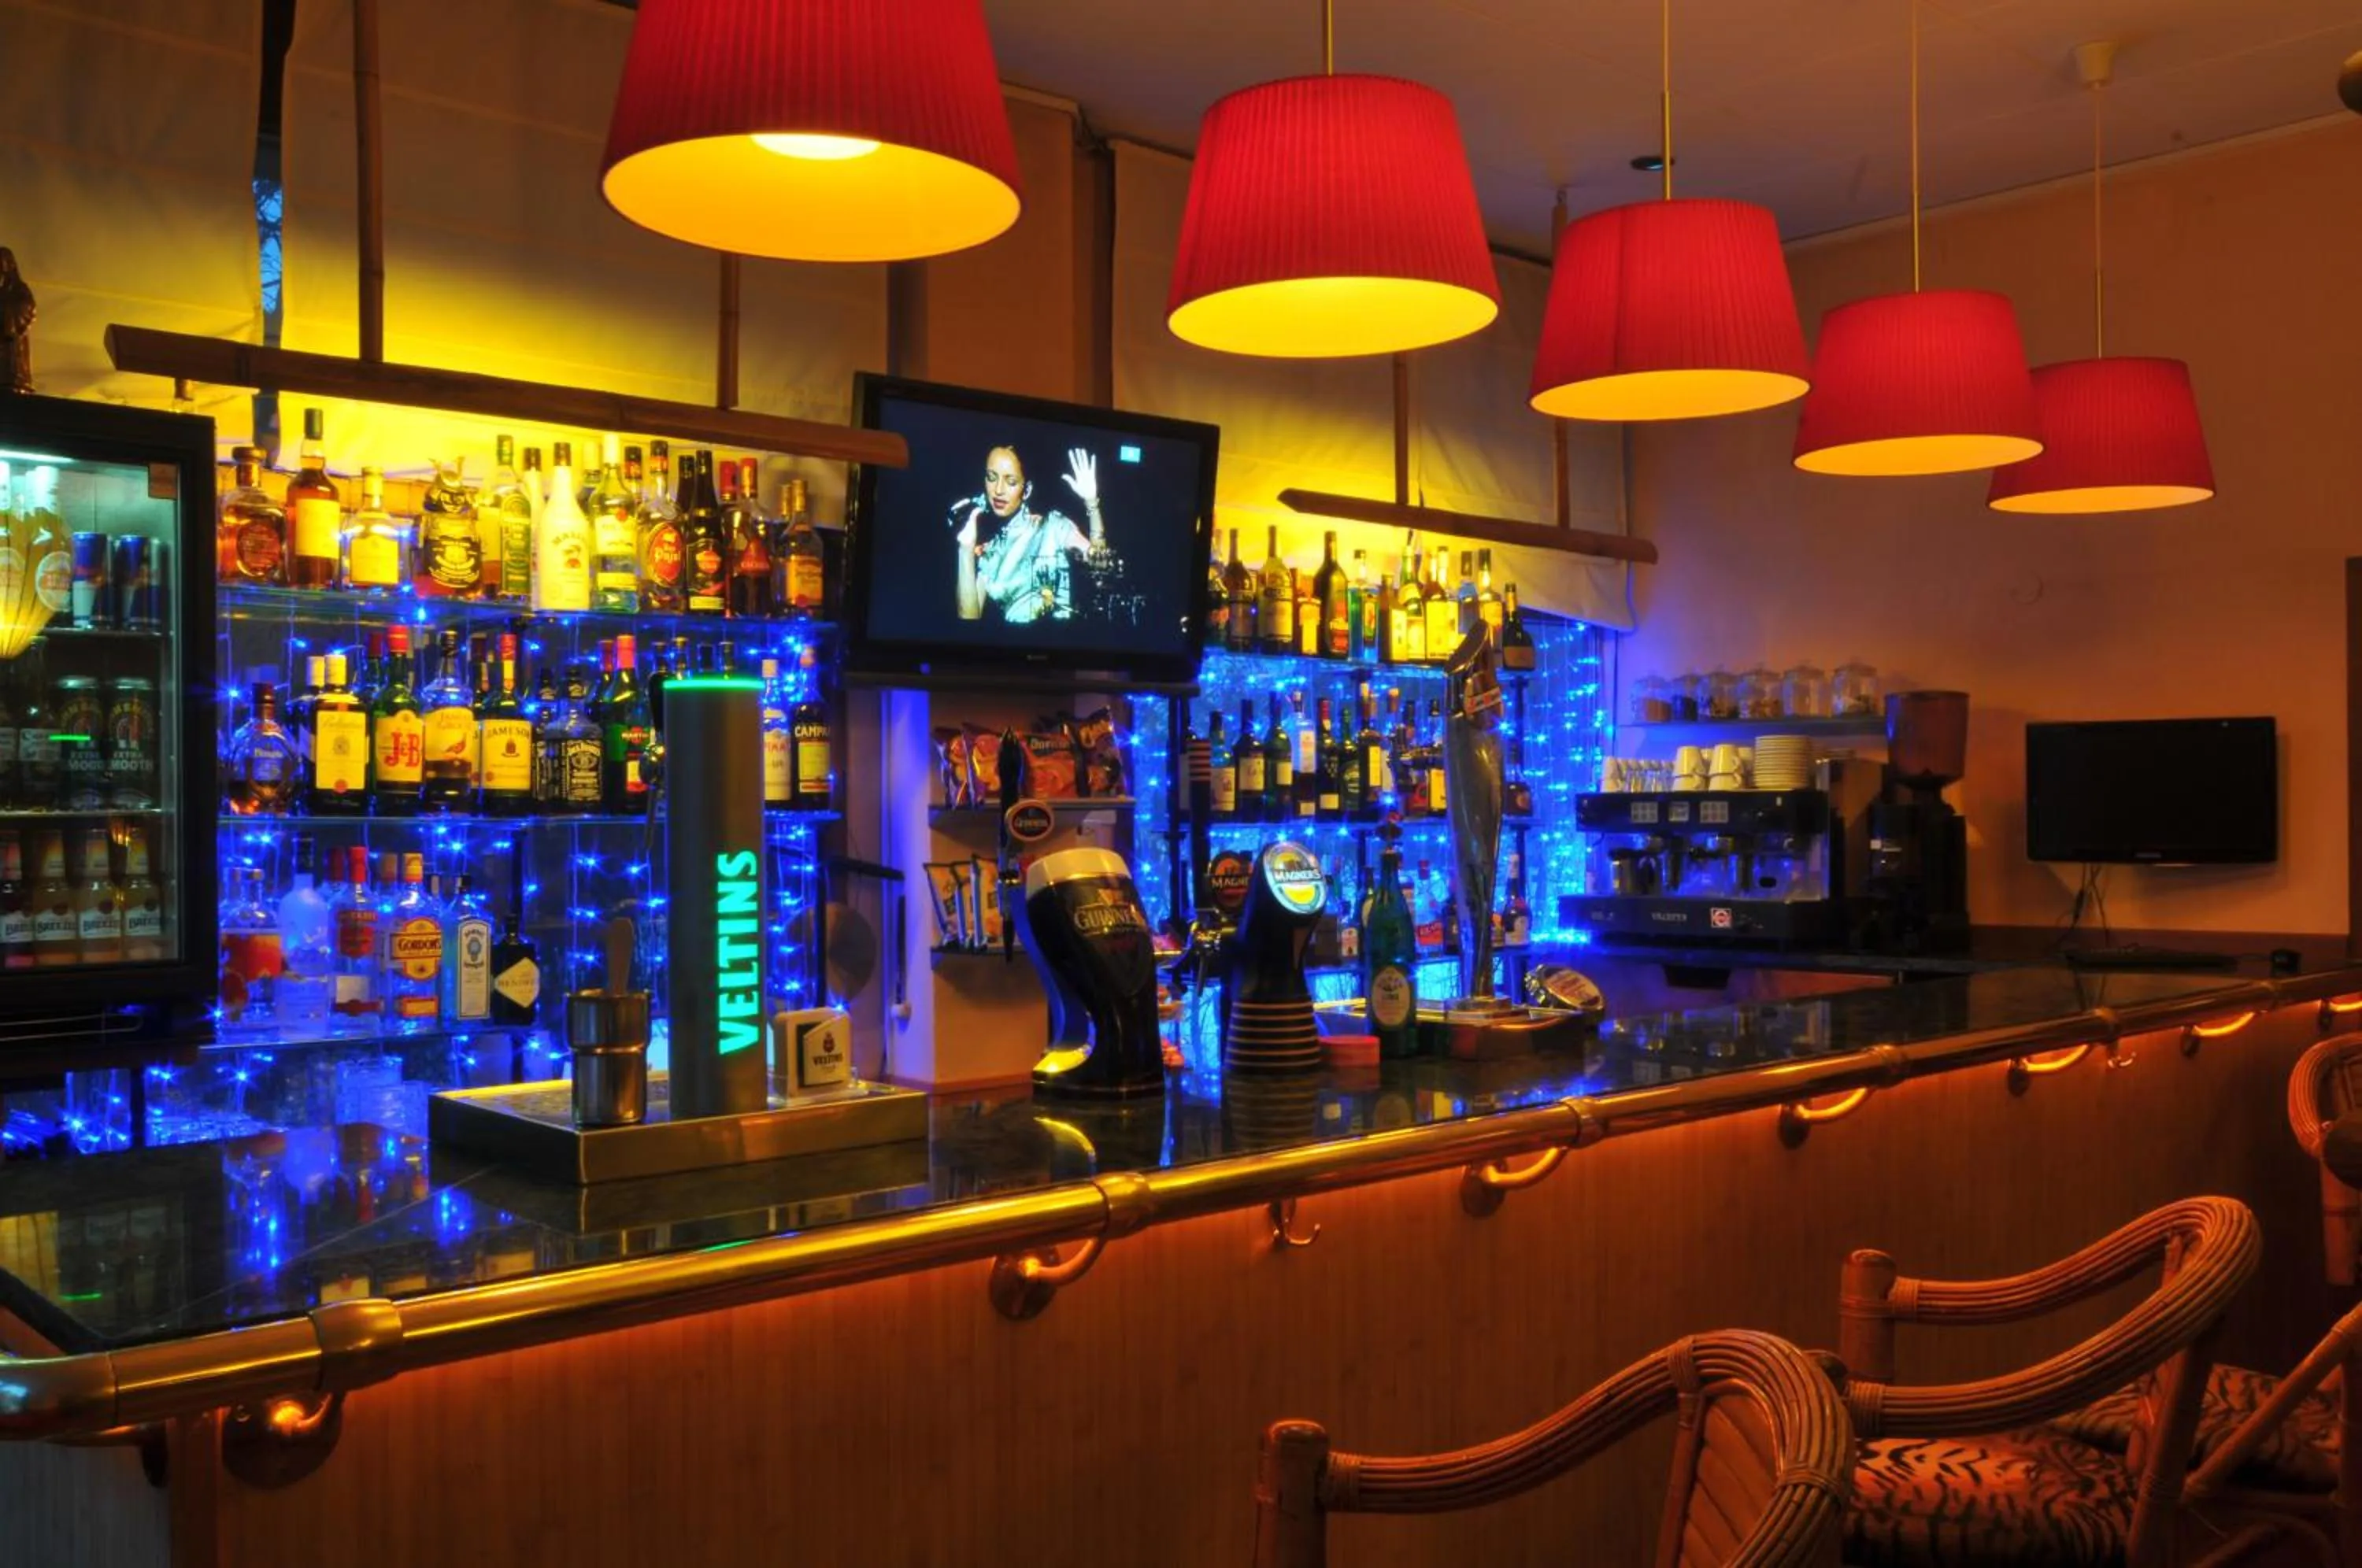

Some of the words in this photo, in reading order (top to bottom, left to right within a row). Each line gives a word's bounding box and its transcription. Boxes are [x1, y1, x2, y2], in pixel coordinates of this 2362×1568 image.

[794, 725, 831, 738] CAMPA
[1074, 905, 1140, 930] GUINNE
[718, 850, 759, 1056] VELTINS
